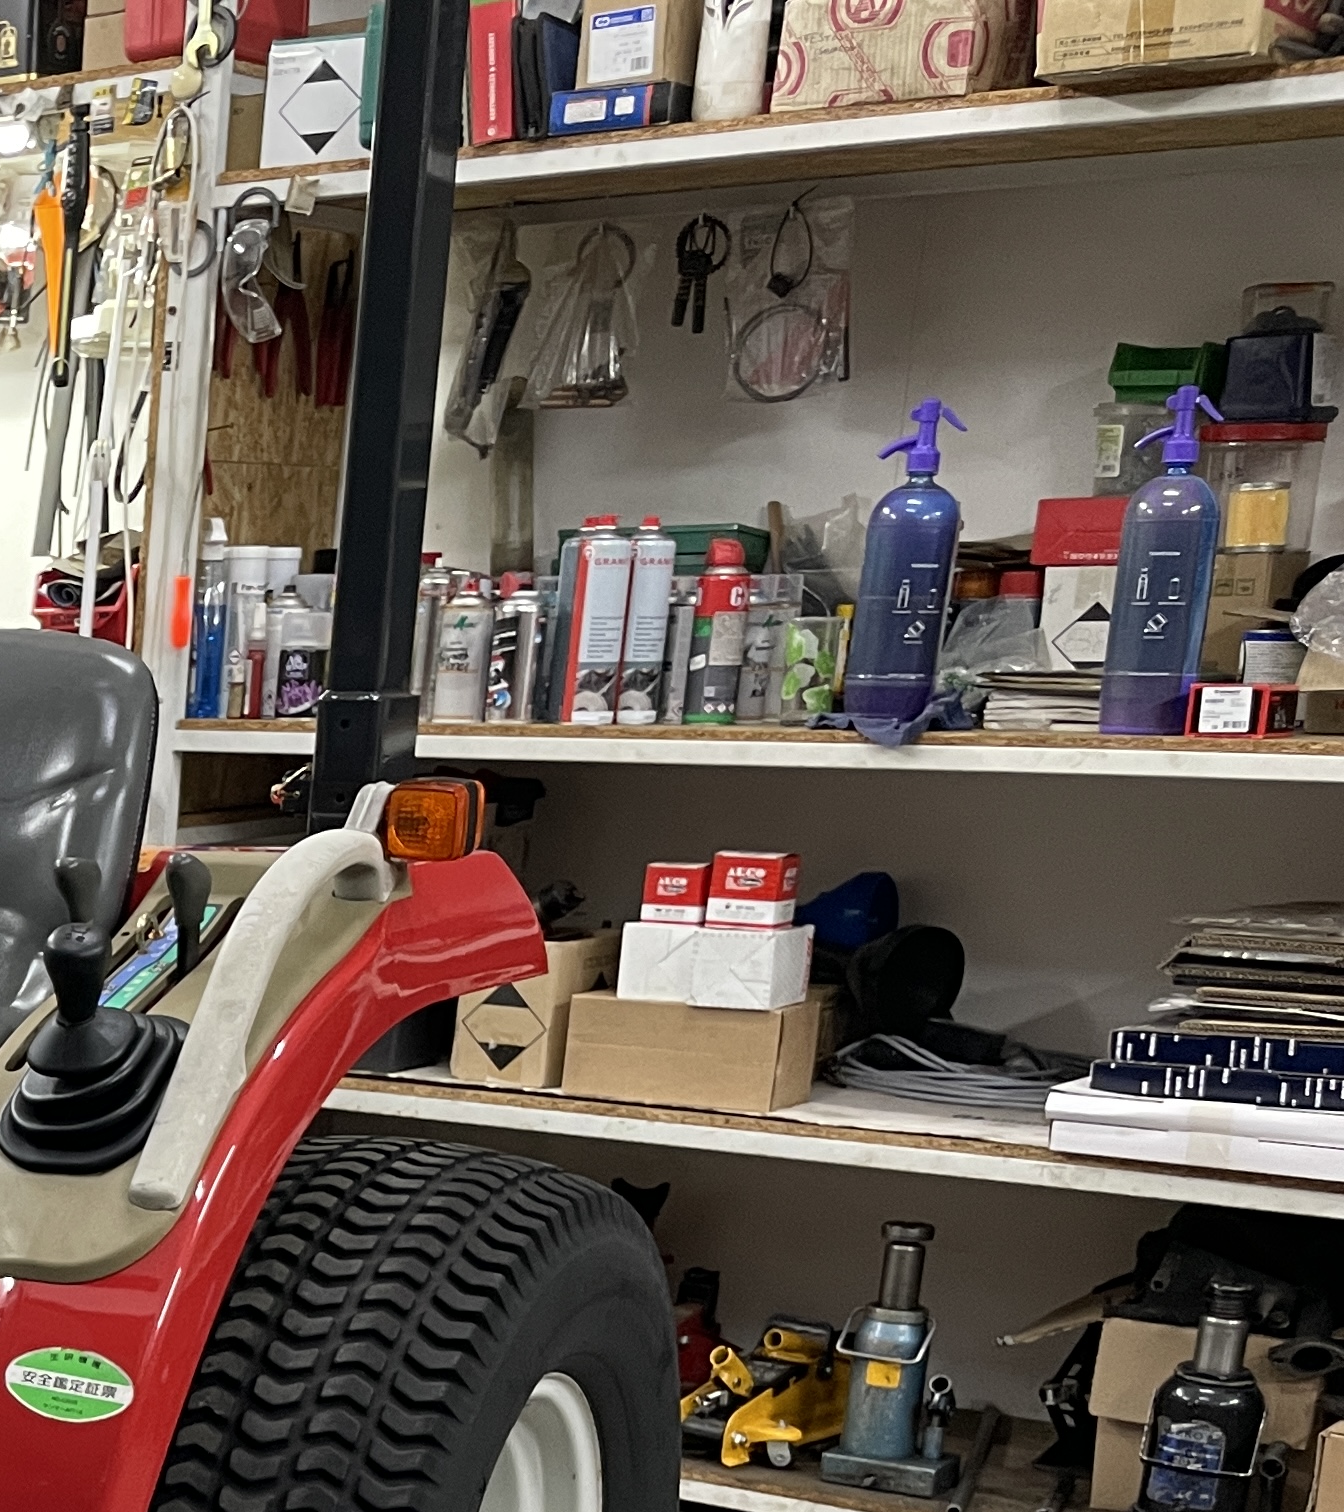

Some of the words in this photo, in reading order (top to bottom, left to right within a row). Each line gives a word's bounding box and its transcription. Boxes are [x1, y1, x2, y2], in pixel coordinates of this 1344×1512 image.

[20, 1370, 118, 1399] 安全鑑定証票
